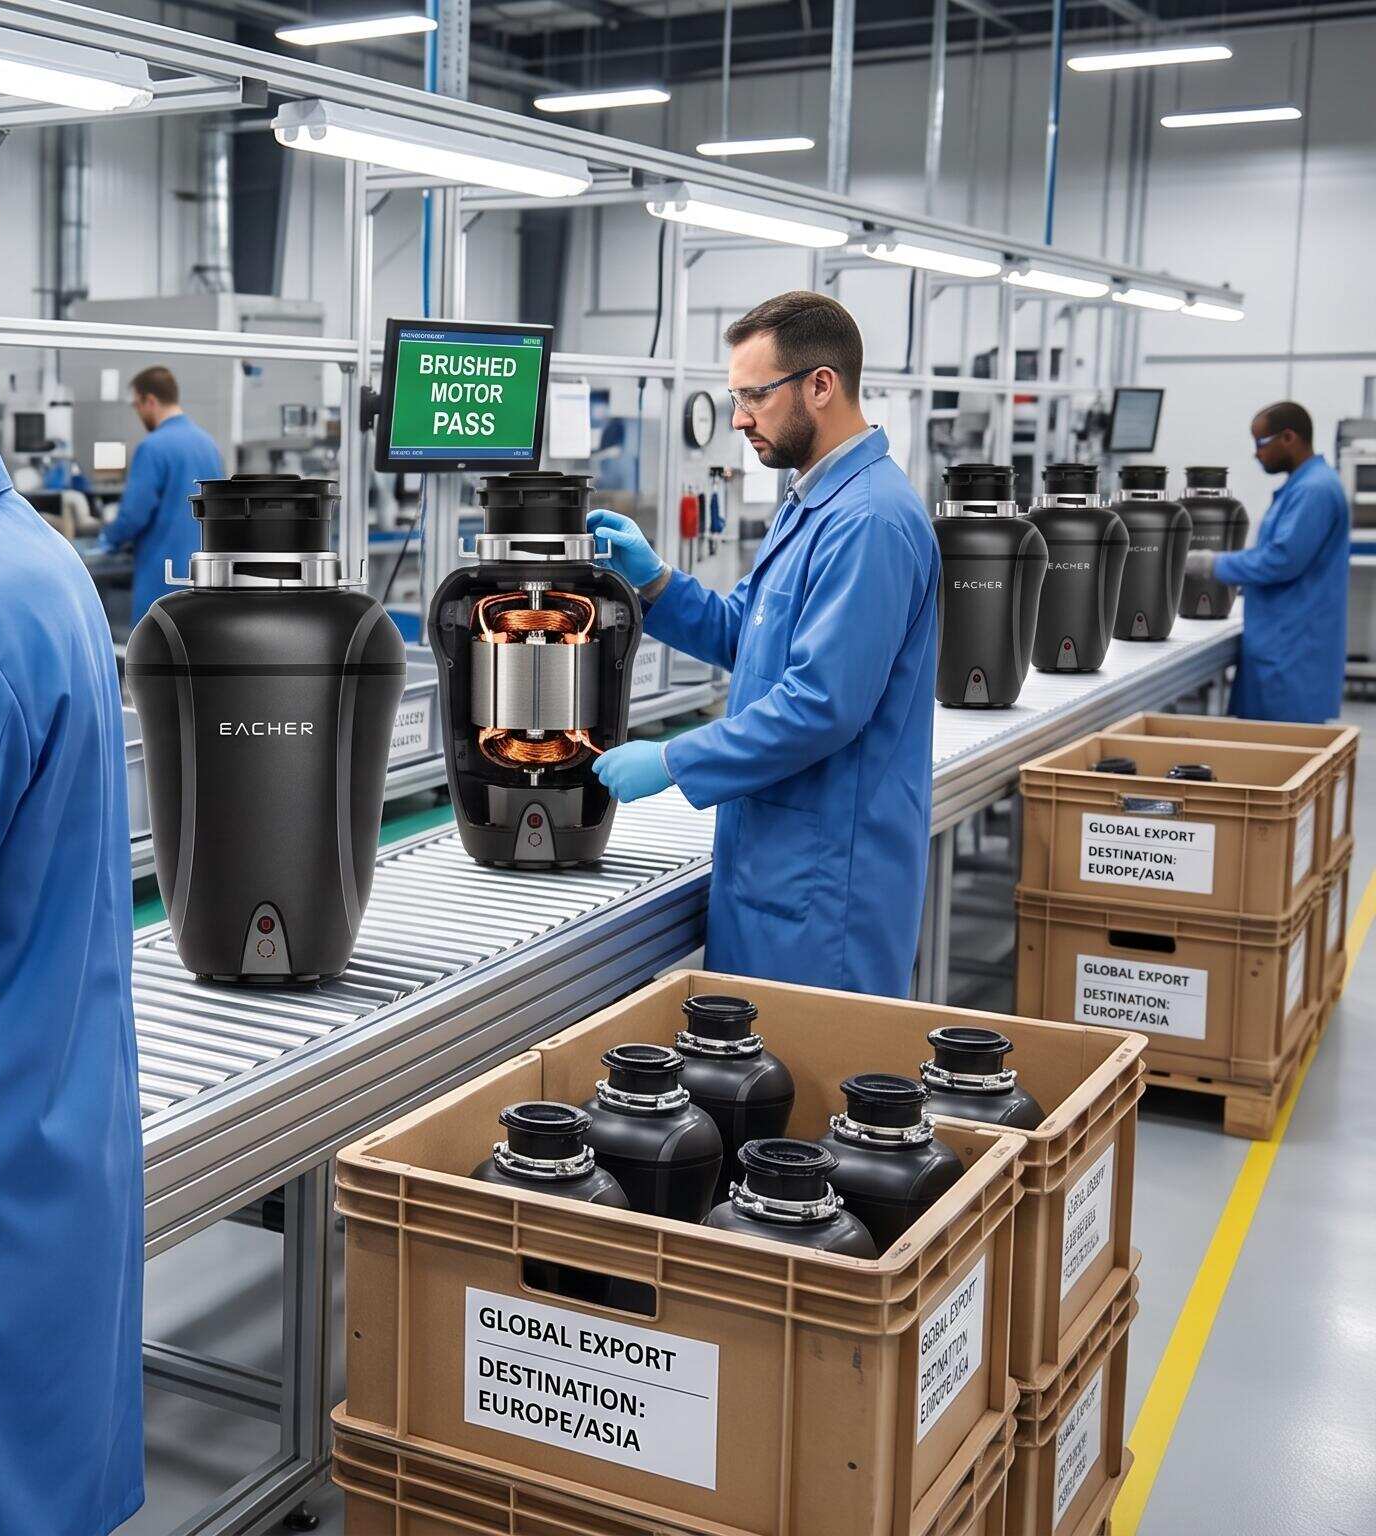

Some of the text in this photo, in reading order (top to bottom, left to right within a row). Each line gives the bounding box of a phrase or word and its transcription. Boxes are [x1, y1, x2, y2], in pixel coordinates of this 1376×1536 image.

[419, 354, 517, 377] BRUSHED
[431, 382, 503, 404] MOTOR
[433, 411, 495, 436] PASS
[1048, 562, 1091, 570] EACHER
[954, 581, 1003, 589] EACHER
[219, 722, 314, 735] EACHER
[1089, 822, 1195, 842] GLOBAL EXPORT
[1088, 846, 1177, 865] DESTINATION:
[1088, 863, 1175, 882] EUROPE/ASIA
[1084, 963, 1190, 987] GLOBAL EXPORT
[1083, 988, 1170, 1010] DESTINATION:
[1083, 1004, 1169, 1026] EUROPE/ASIA
[479, 1307, 677, 1372] GLOBAL EXPORT
[479, 1356, 646, 1418] DESTINATION:
[479, 1389, 641, 1452] EUROPE/ASIA
